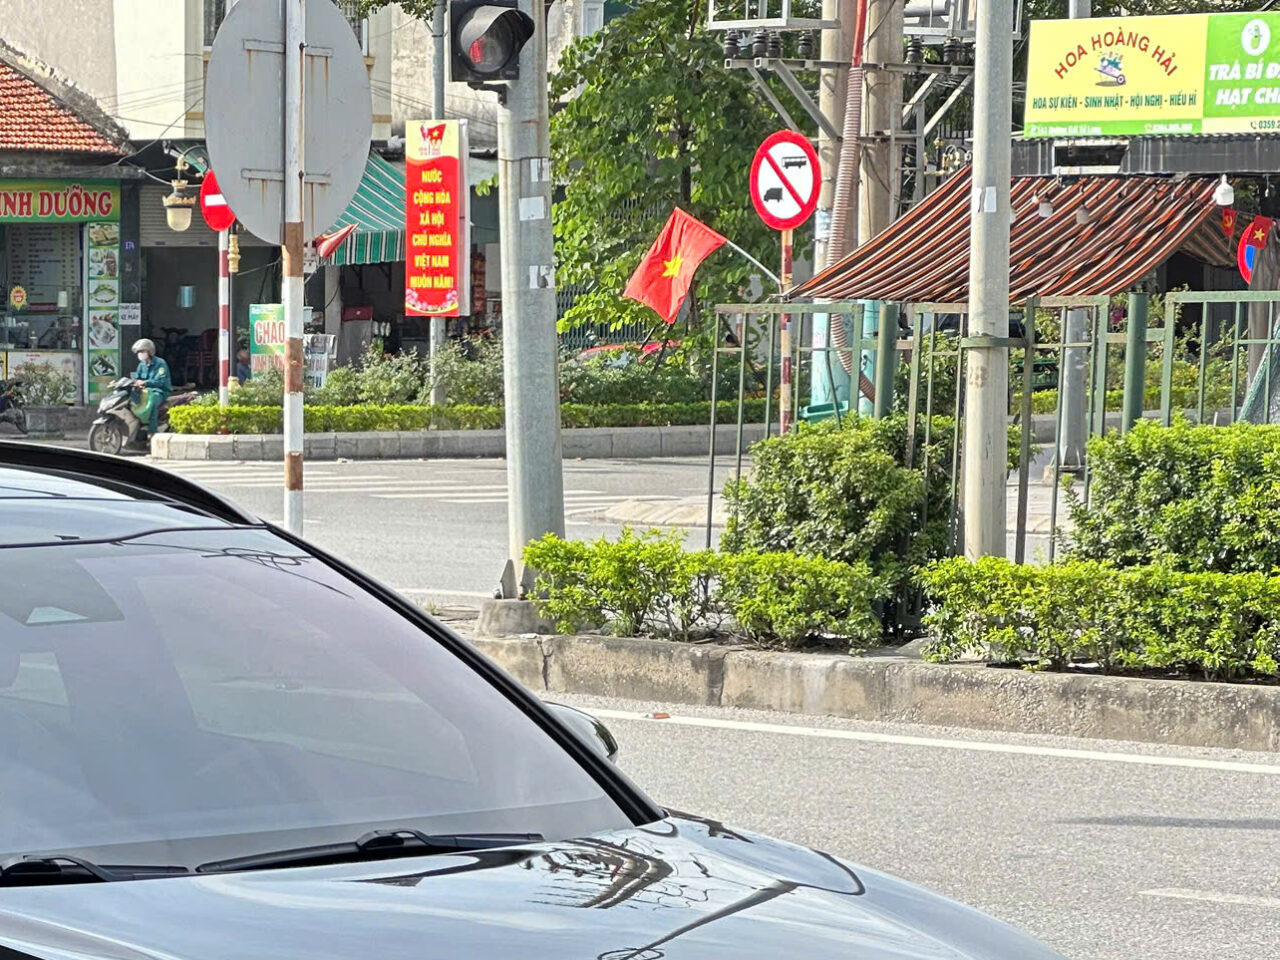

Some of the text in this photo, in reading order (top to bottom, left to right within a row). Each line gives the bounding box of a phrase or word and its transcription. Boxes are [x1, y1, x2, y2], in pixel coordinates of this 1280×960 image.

[1054, 26, 1178, 79] HOA HOÀNG HẢI
[1209, 60, 1241, 80] TRÀ
[1245, 58, 1264, 80] BÍ
[1032, 97, 1047, 109] HOA
[1084, 96, 1102, 109] SINH
[1216, 88, 1253, 110] HẠT
[38, 185, 113, 217] DƯỠNG
[431, 255, 449, 267] NAM
